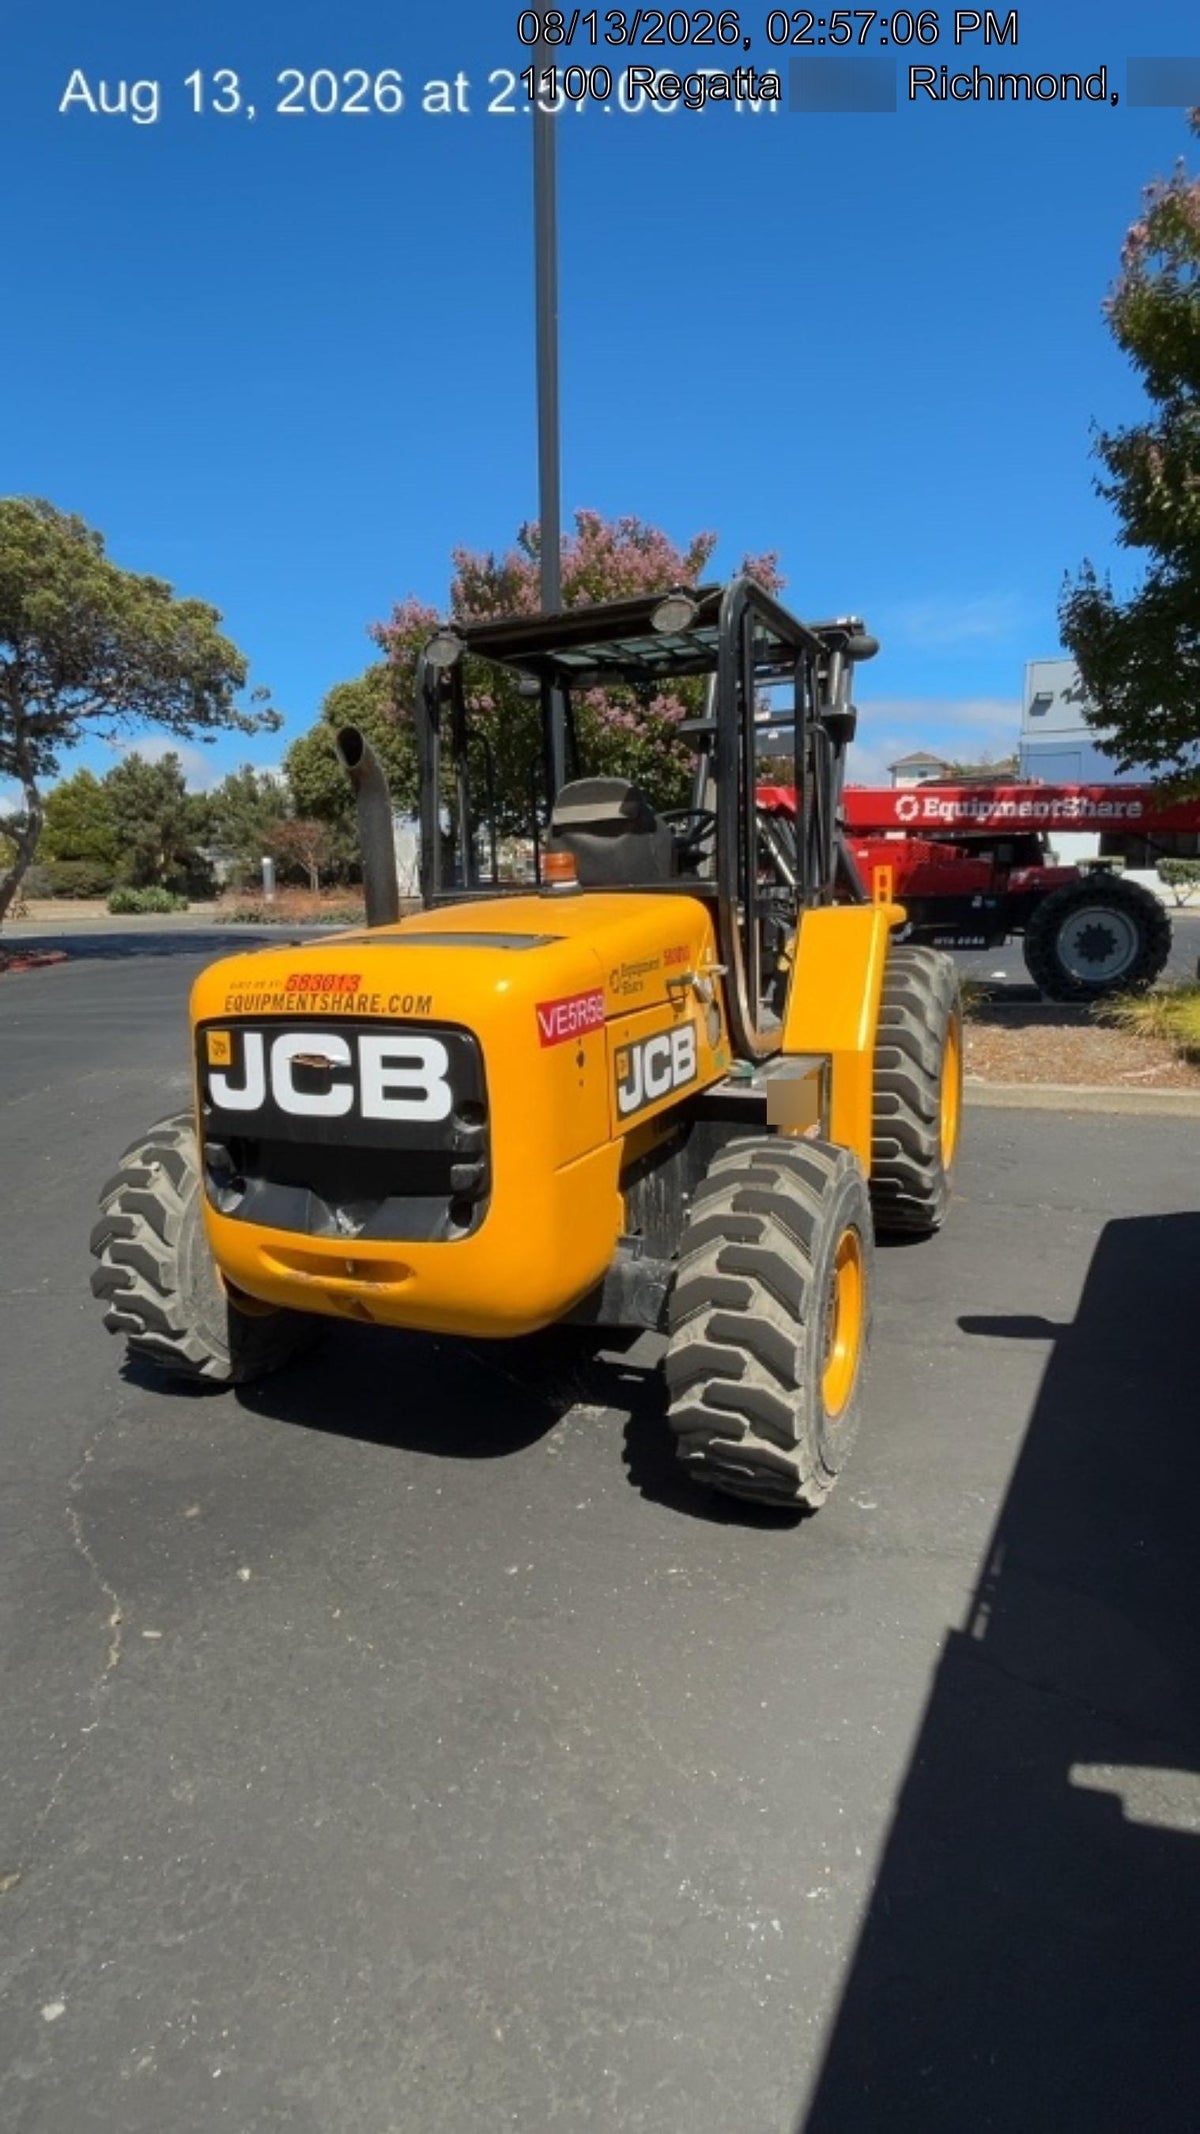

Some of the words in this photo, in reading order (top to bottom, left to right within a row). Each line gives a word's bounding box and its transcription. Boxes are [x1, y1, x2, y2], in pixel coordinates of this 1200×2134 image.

[922, 797, 1143, 821] EquipmentShare
[224, 993, 432, 1014] EQUIPMENTSHARE.COM
[208, 1032, 452, 1122] JCB
[617, 1025, 696, 1114] JCB
